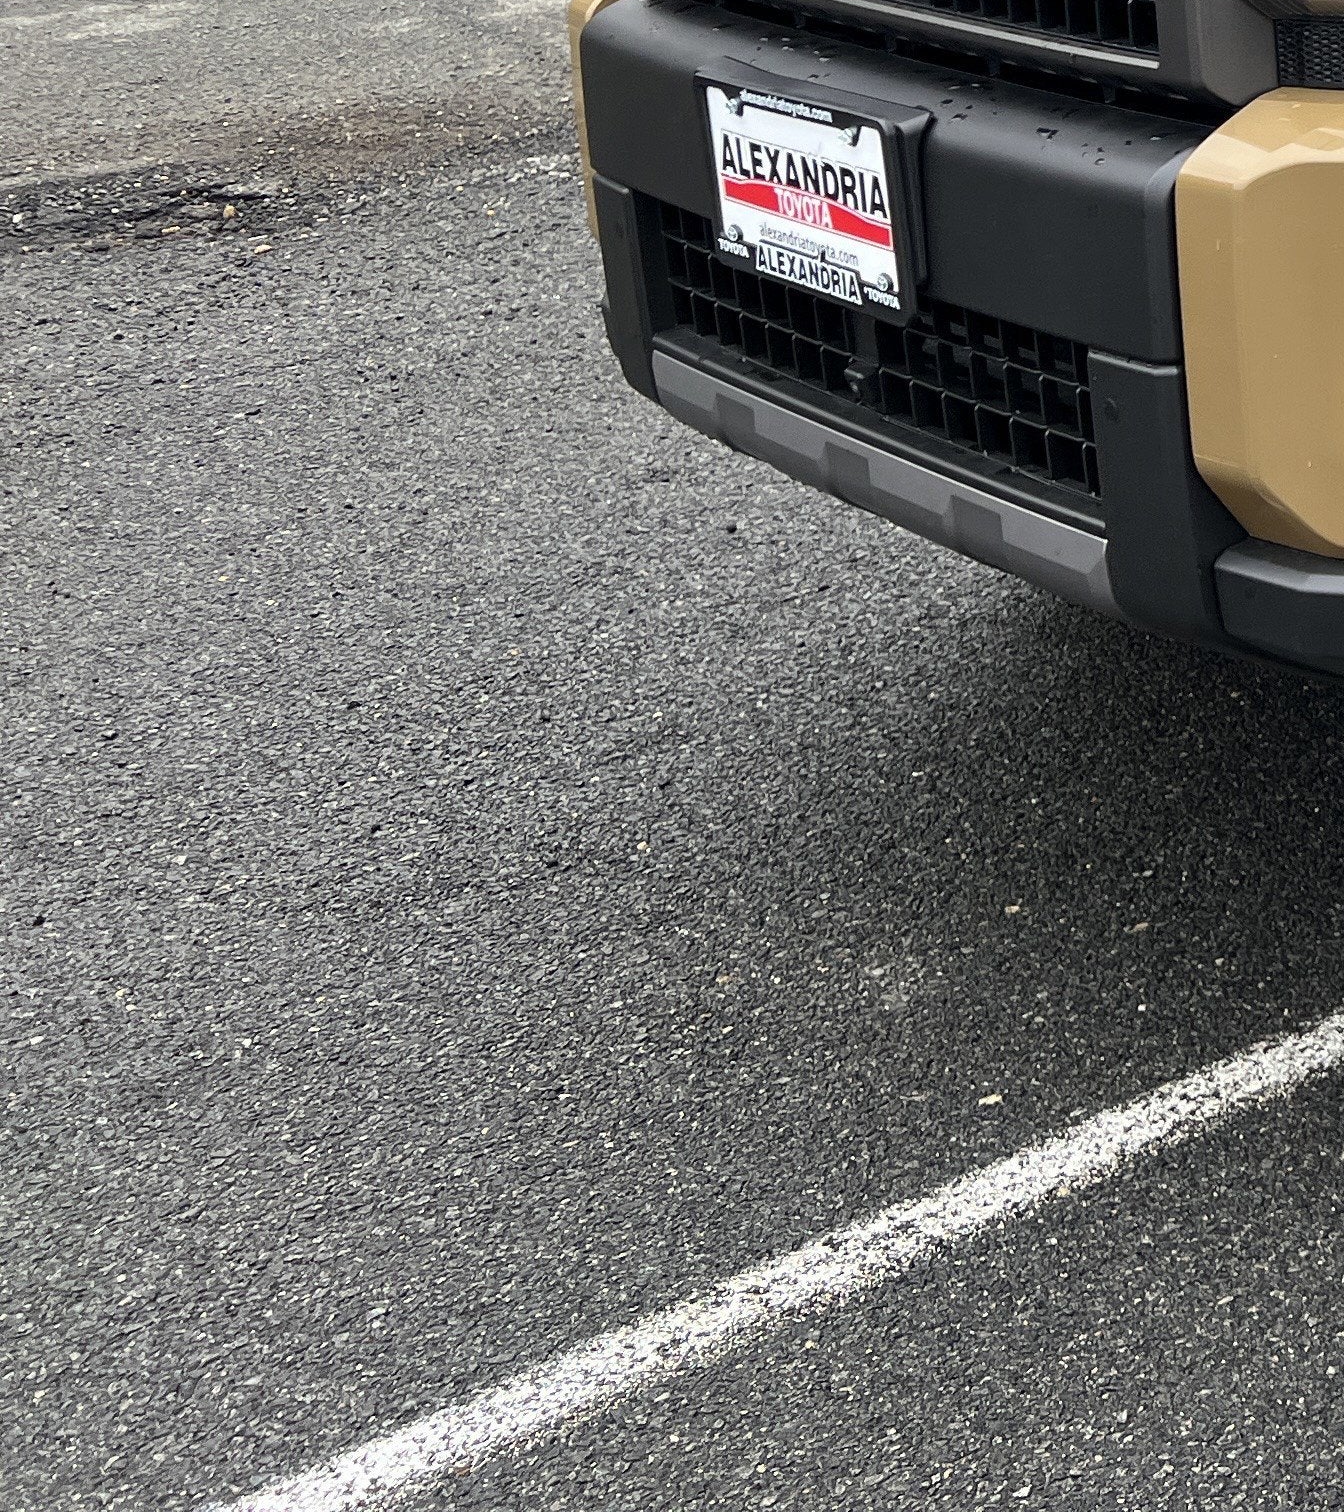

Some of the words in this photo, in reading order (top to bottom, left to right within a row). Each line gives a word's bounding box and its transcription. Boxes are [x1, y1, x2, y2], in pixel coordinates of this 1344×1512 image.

[722, 133, 889, 220] ALEXANDRIA
[774, 187, 833, 229] TOYOTA
[759, 222, 860, 267] alexandriatoyota.com
[717, 238, 750, 258] TOYOTA
[757, 244, 860, 303] ALEXANDRIA
[864, 286, 901, 310] TOYOTA
